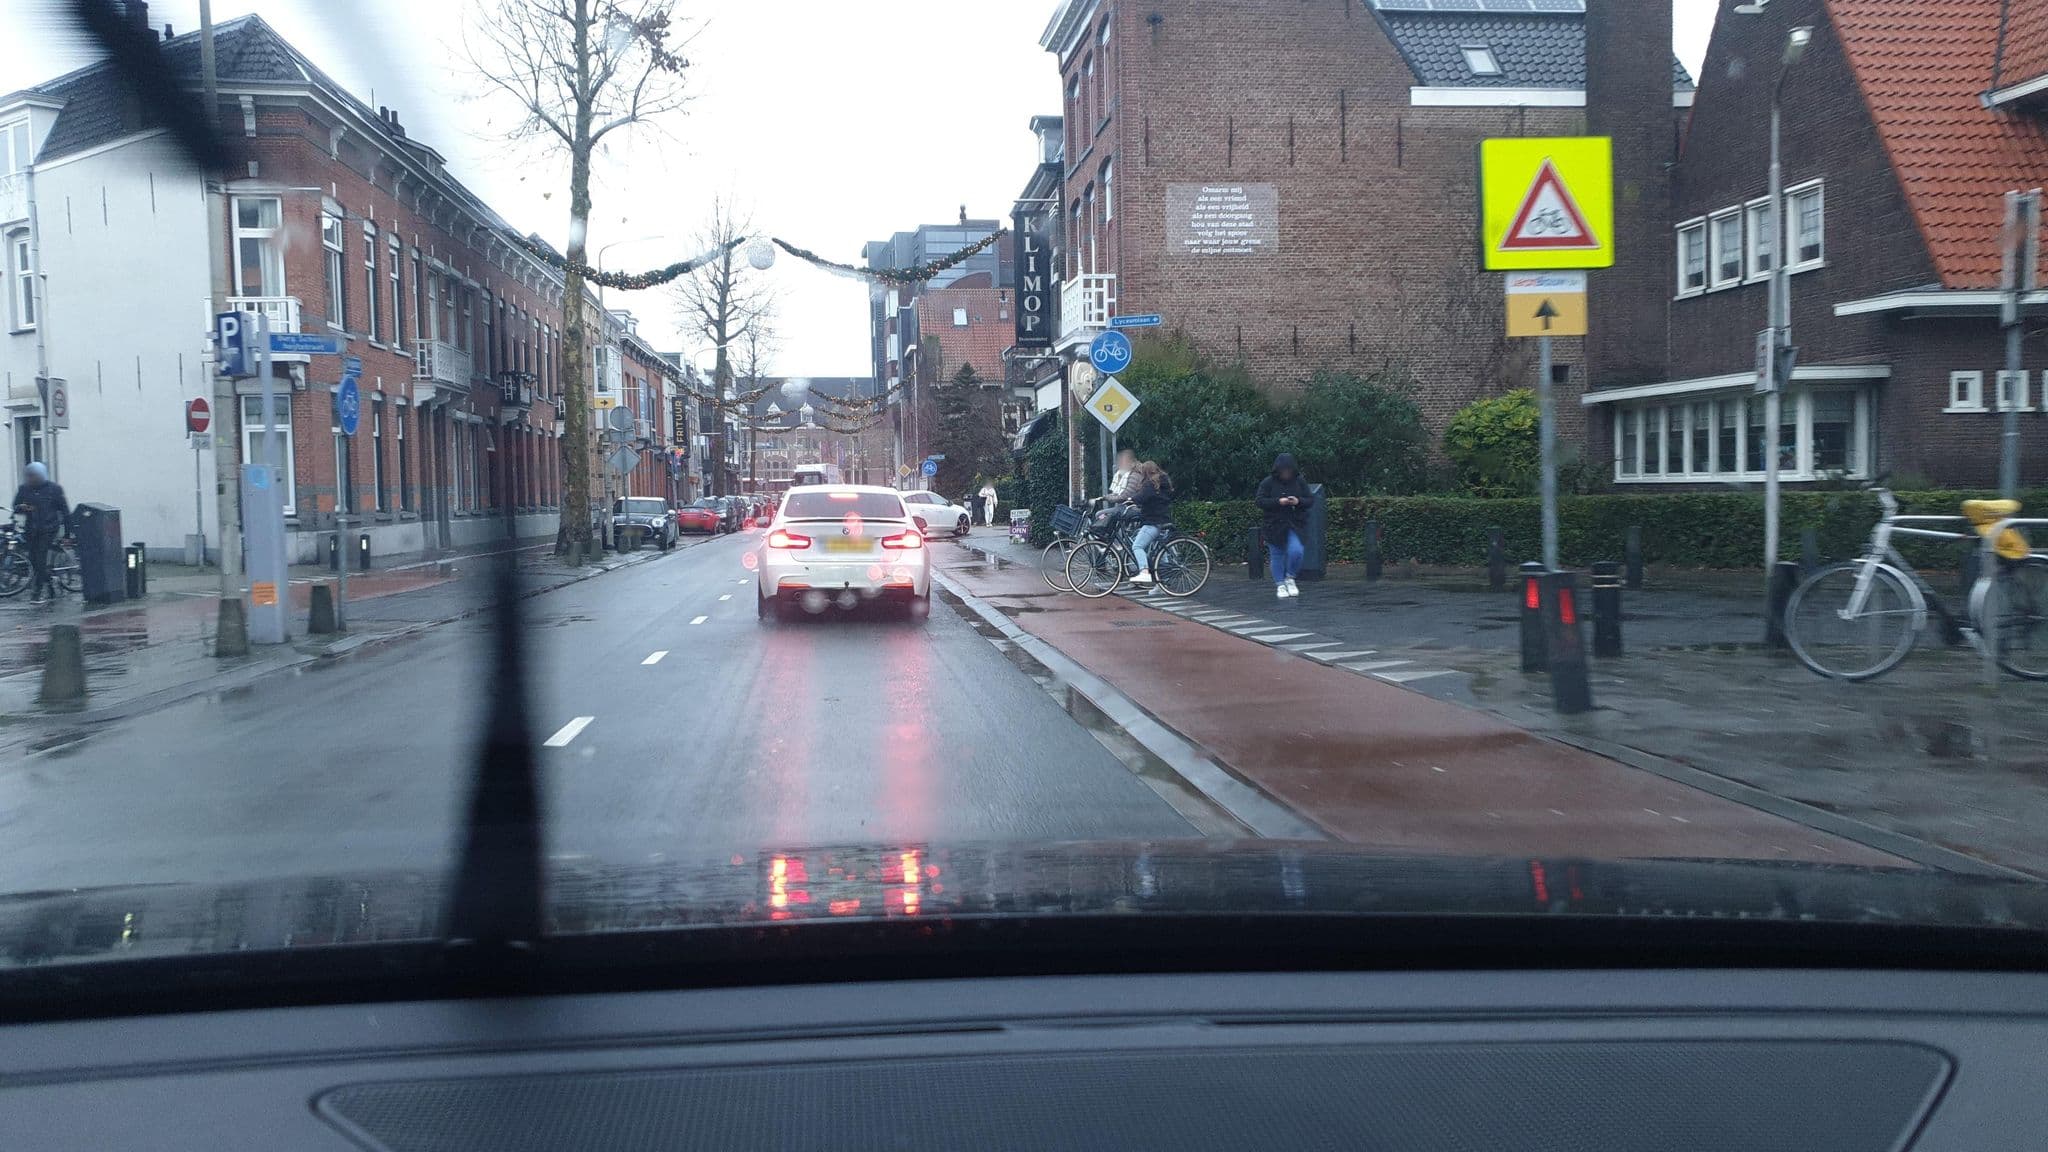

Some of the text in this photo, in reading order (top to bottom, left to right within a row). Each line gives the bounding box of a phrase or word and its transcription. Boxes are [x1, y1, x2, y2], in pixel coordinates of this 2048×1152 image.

[1023, 216, 1042, 332] KLIMOP
[219, 316, 239, 349] P
[1114, 317, 1151, 326] Lyceumlaan
[675, 400, 684, 443] FRITUUR
